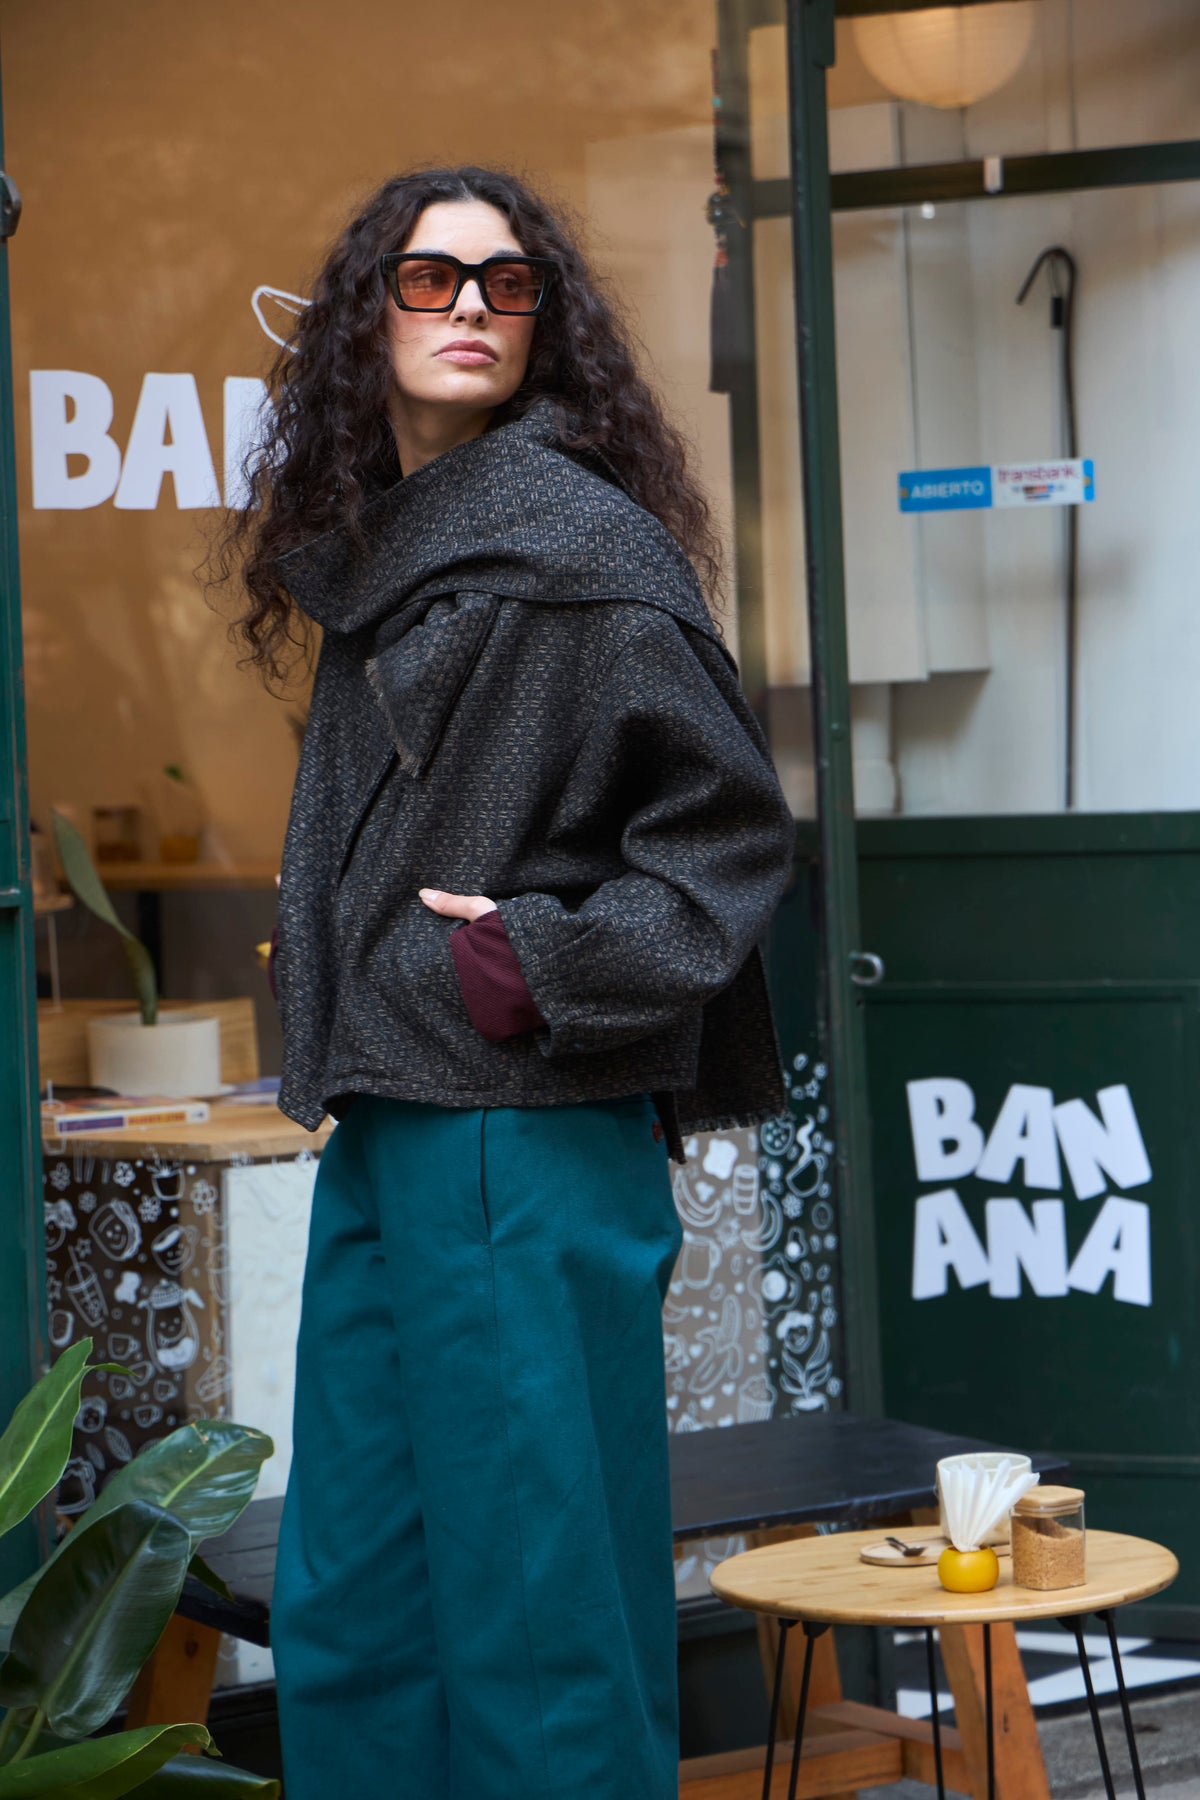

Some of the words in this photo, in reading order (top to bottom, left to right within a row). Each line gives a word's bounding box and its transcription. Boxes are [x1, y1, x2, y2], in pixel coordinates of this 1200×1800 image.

[911, 480, 985, 499] ABIERTO
[906, 1077, 1152, 1201] BAN
[912, 1188, 1152, 1307] ANA
